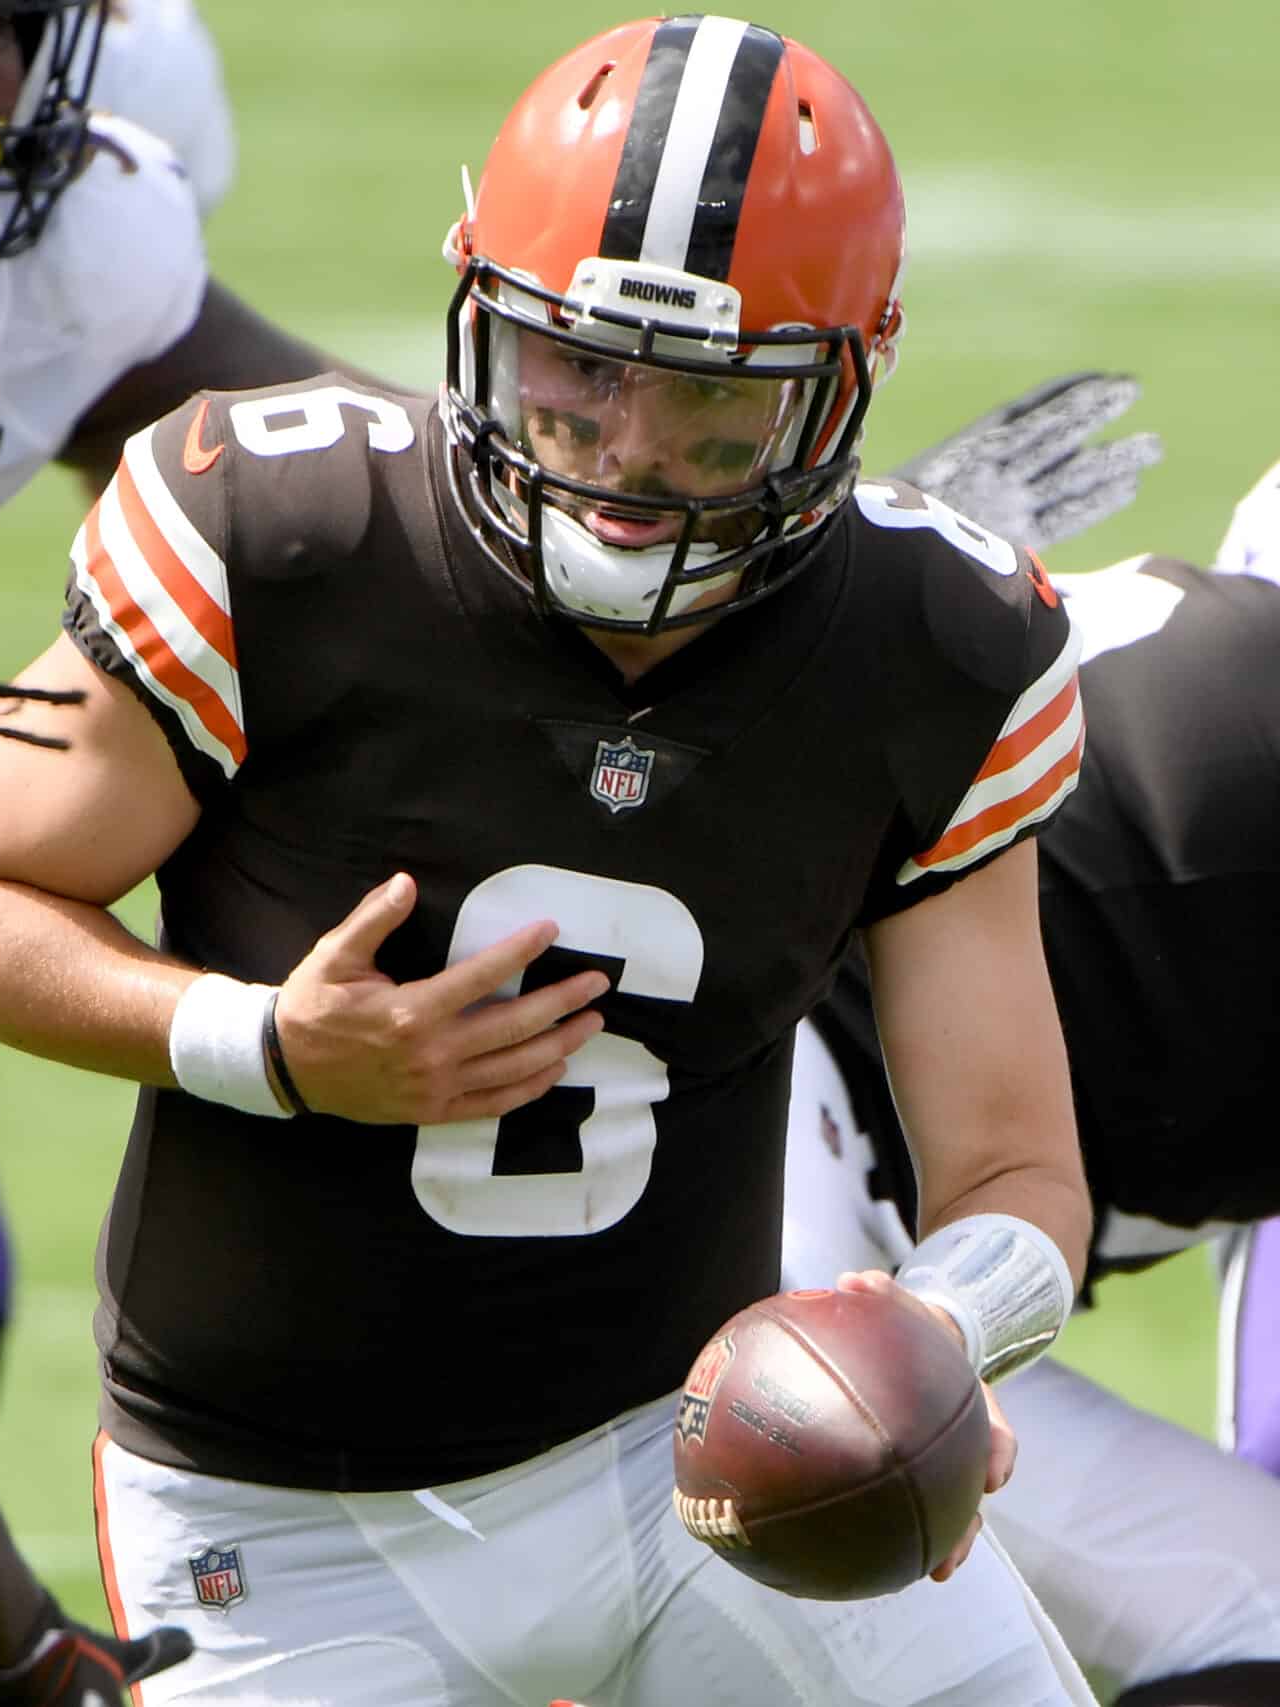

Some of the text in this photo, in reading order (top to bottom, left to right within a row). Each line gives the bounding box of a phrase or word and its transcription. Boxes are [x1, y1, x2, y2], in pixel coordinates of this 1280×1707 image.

[619, 278, 697, 309] BROWNS
[230, 386, 415, 456] 6
[599, 767, 638, 798] NFL
[411, 864, 704, 1236] 6
[199, 1571, 238, 1601] NFL
